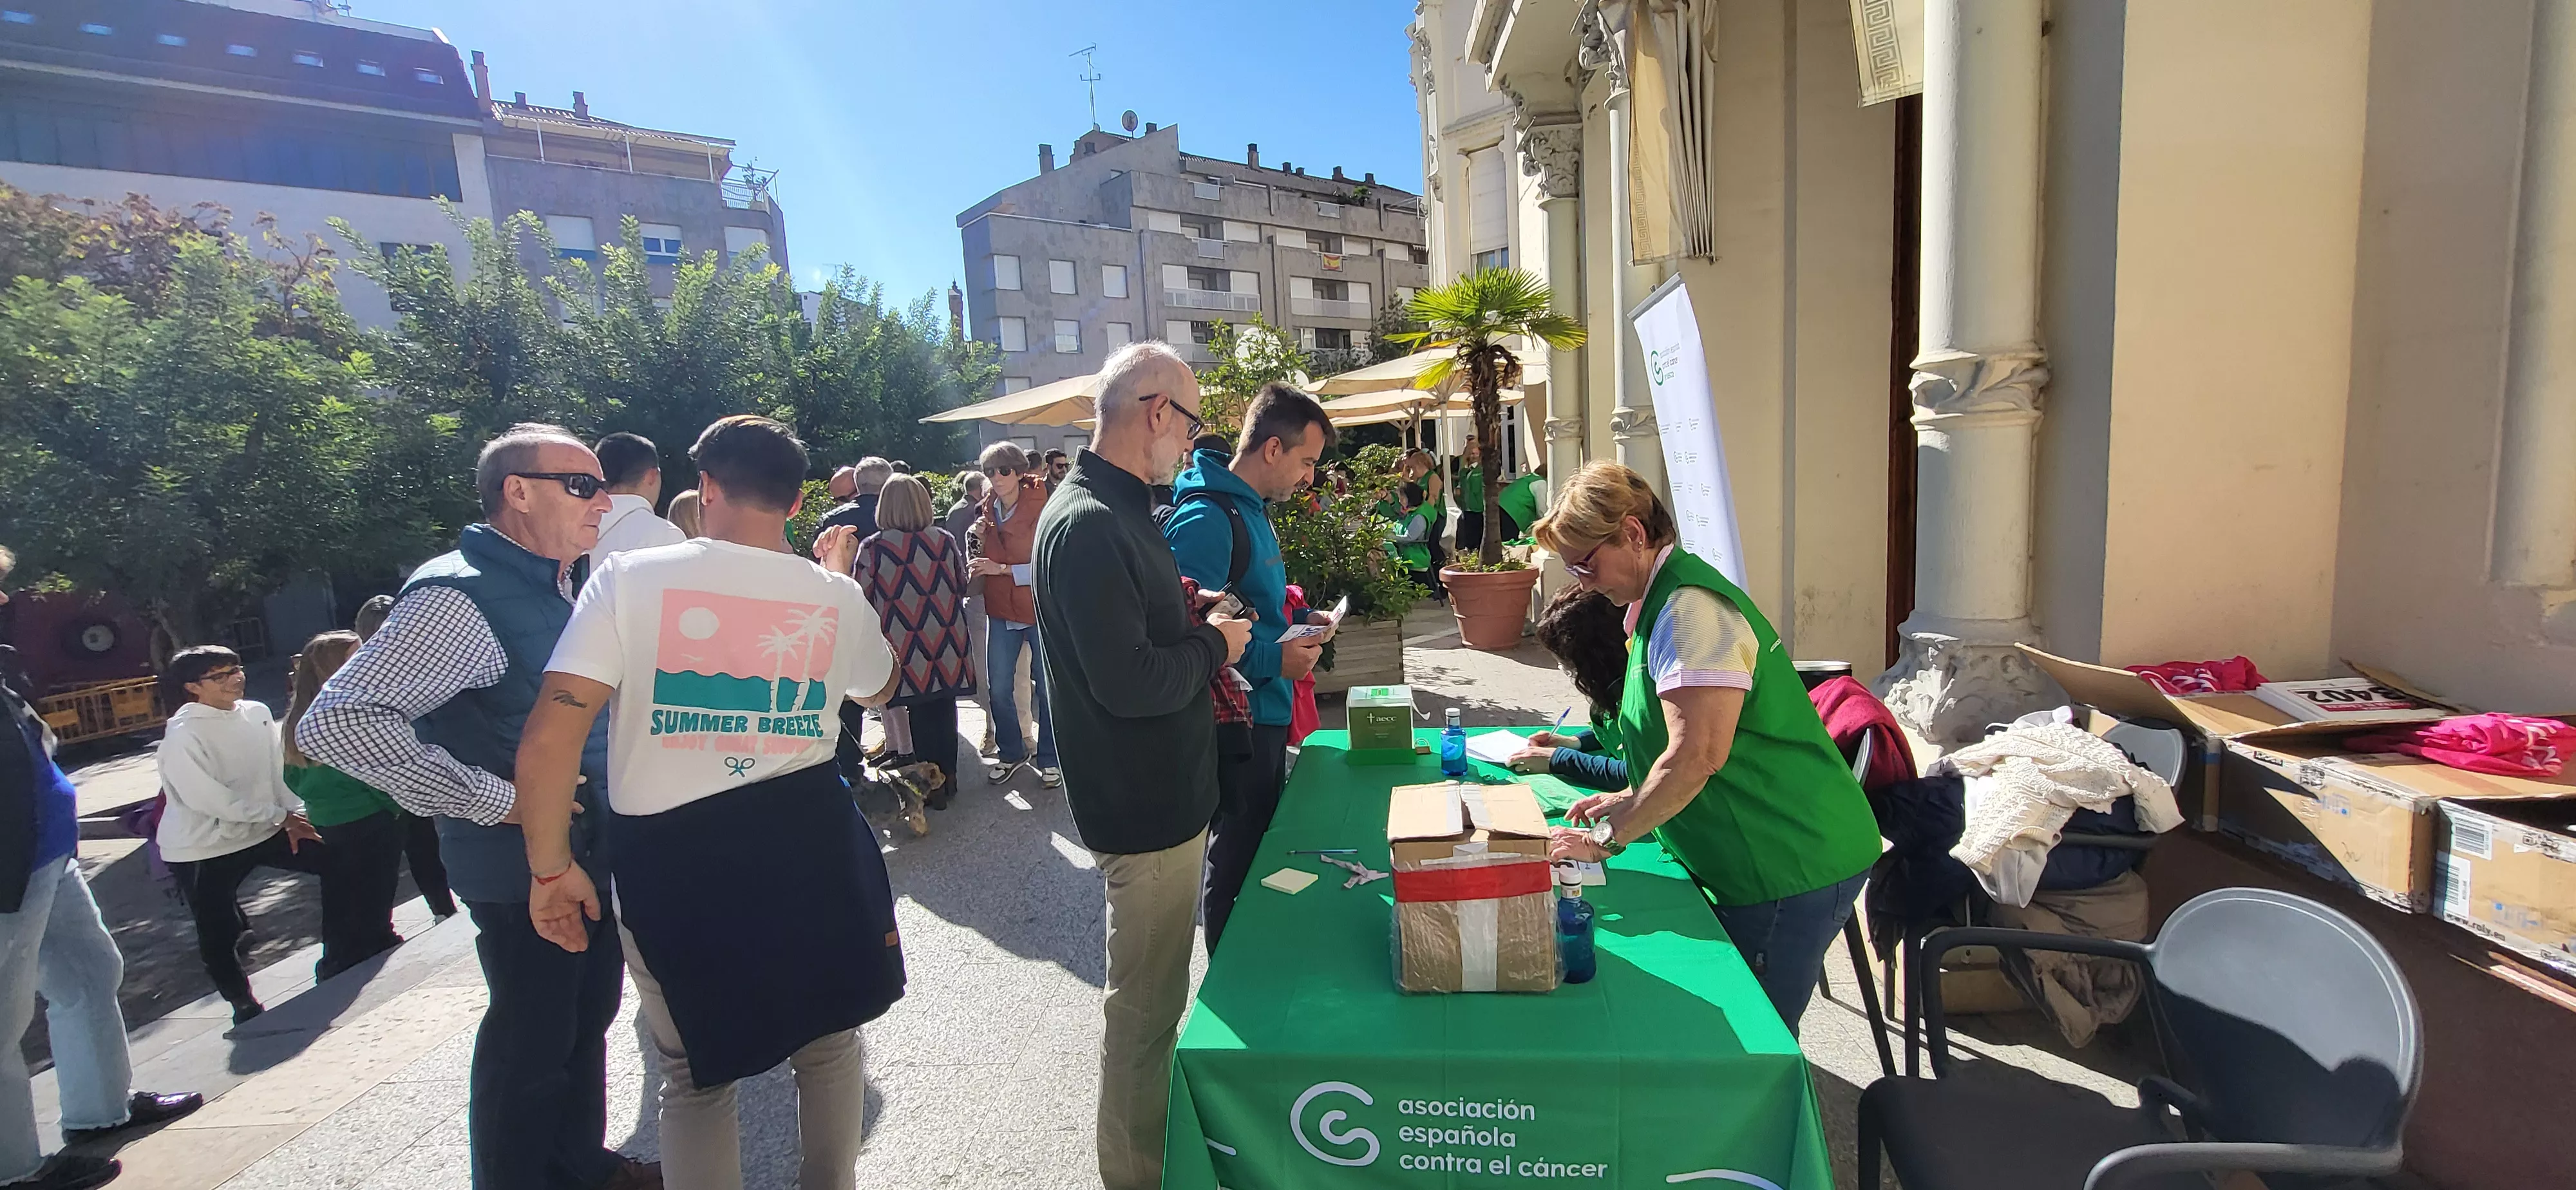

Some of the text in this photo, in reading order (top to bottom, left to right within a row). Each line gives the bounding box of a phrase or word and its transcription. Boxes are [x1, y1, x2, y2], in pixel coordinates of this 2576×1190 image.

[650, 710, 824, 737] SUMMER BREEZE
[1398, 1097, 1536, 1121] asociación
[1398, 1124, 1517, 1148] española
[1399, 1152, 1609, 1178] contra el cáncer
